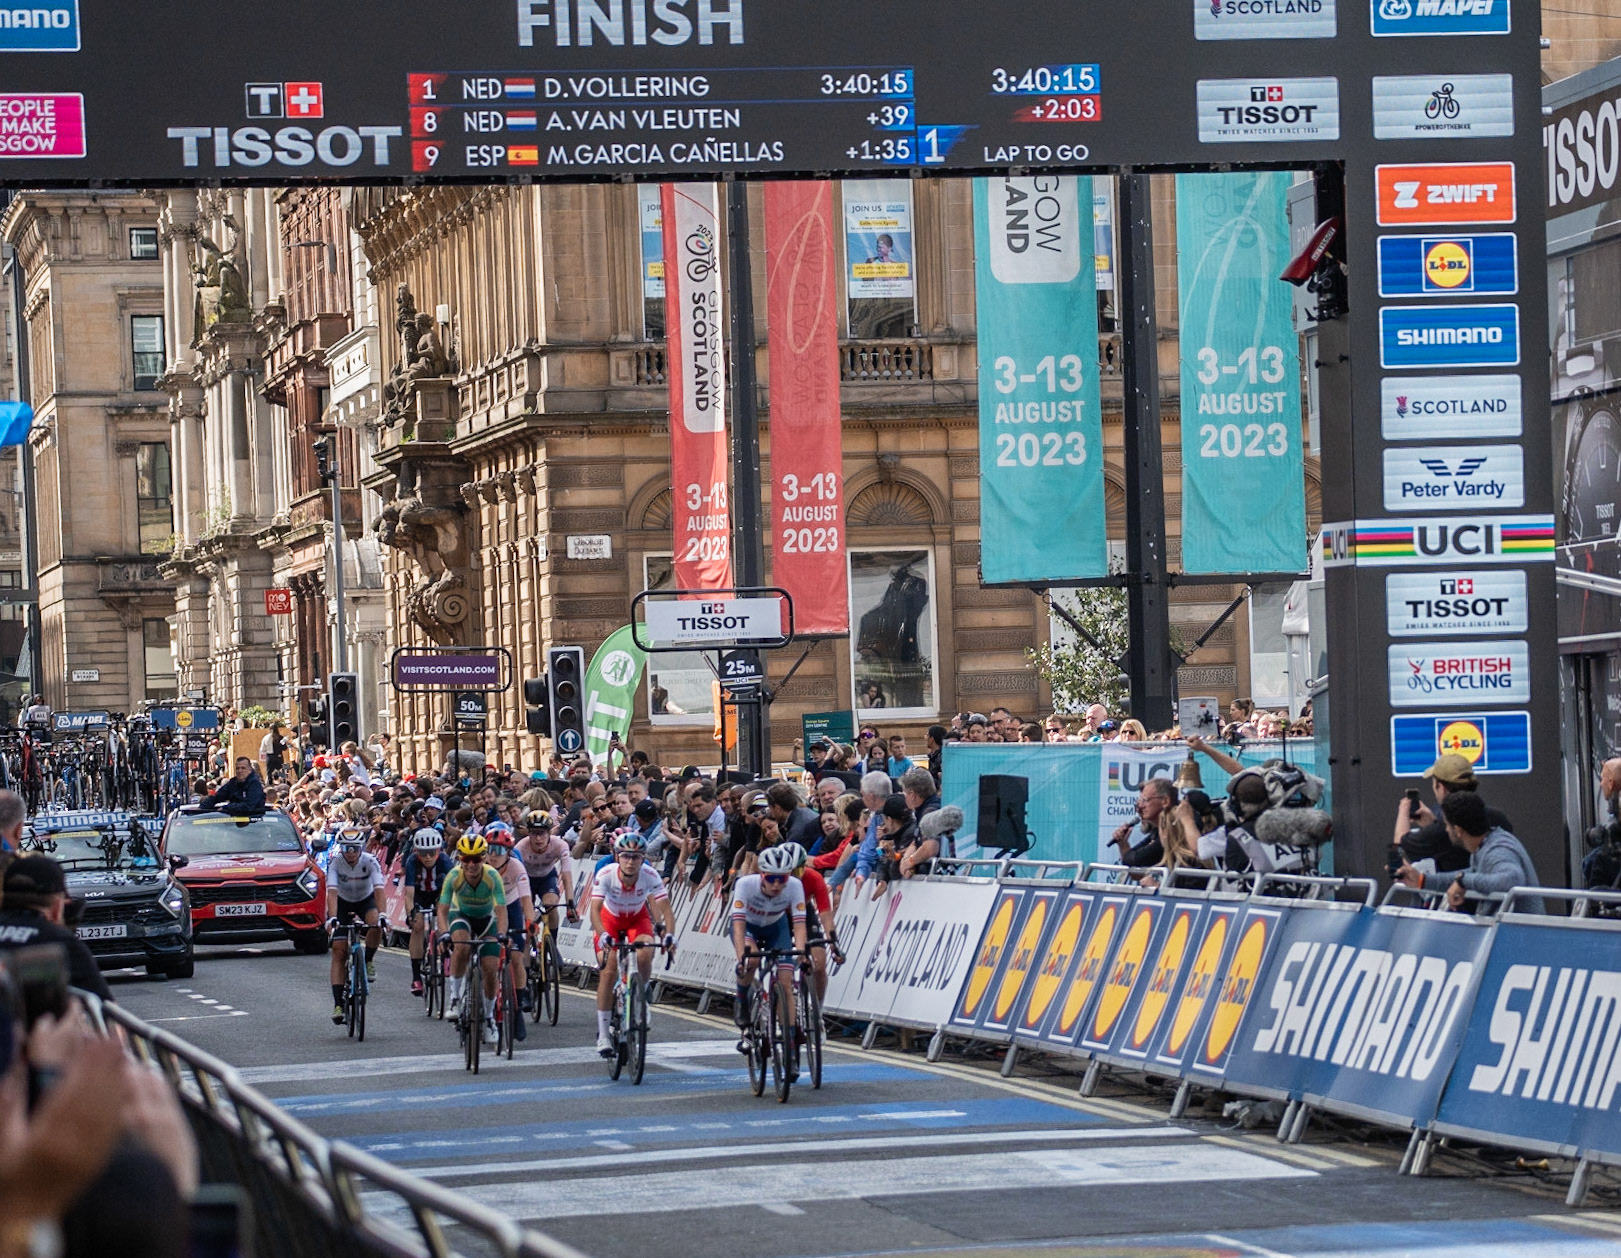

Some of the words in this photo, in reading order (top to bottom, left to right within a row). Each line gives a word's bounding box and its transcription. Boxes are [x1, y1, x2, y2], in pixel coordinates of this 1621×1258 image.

[1226, 0, 1322, 15] SCOTLAND
[1416, 0, 1496, 16] MAPEI
[517, 0, 744, 46] FINISH
[423, 79, 436, 99] 1
[463, 78, 502, 99] NED
[545, 76, 710, 98] D.VOLLERING
[821, 74, 908, 94] 3:40:15
[992, 67, 1096, 92] 3:40:15
[424, 112, 437, 132] 8
[464, 111, 502, 132] NED
[546, 110, 626, 131] A.VAN
[632, 108, 740, 129] VLEUTEN
[867, 106, 908, 126] +39
[1032, 98, 1096, 120] +2:03
[1217, 105, 1318, 125] TISSOT
[2, 118, 56, 134] MAKE
[167, 126, 402, 167] TISSOT
[425, 146, 439, 166] 9
[466, 146, 505, 166] ESP
[547, 144, 664, 165] M.GARCIA
[670, 137, 784, 162] CAÑELLAS
[846, 139, 910, 160] +1:35
[984, 146, 1020, 162] LAP
[1024, 146, 1052, 162] TO
[1056, 144, 1090, 160] GO
[1544, 98, 1621, 207] ISSO
[1427, 184, 1497, 203] ZWIFT
[1398, 326, 1502, 346] SHIMANO
[692, 292, 709, 412] SCOTLAND
[708, 290, 722, 409] GLASGOW
[994, 354, 1082, 394] 3-13
[1198, 346, 1284, 384] 3-13
[995, 401, 1085, 424] AUGUST
[1198, 392, 1286, 414] AUGUST
[1412, 399, 1506, 414] SCOTLAND
[996, 432, 1086, 466] 2023
[1200, 423, 1288, 458] 2023
[782, 472, 836, 501] 3-13
[1402, 481, 1449, 498] Peter
[1454, 480, 1506, 500] Vardy
[686, 514, 728, 532] AUGUST
[782, 505, 838, 522] AUGUST
[686, 537, 728, 561] 2023
[782, 526, 838, 553] 2023
[1332, 529, 1347, 559] UCI
[1417, 524, 1494, 556] UCI
[1406, 598, 1508, 618] TISSOT
[677, 616, 750, 630] TISSOT
[402, 666, 495, 674] VISITSCOTLAND.COM
[1434, 657, 1511, 674] BRITISH
[1434, 674, 1511, 690] CYCLING
[34, 812, 130, 829] SHIMANO
[218, 905, 242, 916] SM23
[244, 904, 263, 914] KJZ
[103, 926, 123, 937] ZTJ
[874, 920, 969, 990] SCOTLAND
[1253, 942, 1473, 1081] SHIMANO
